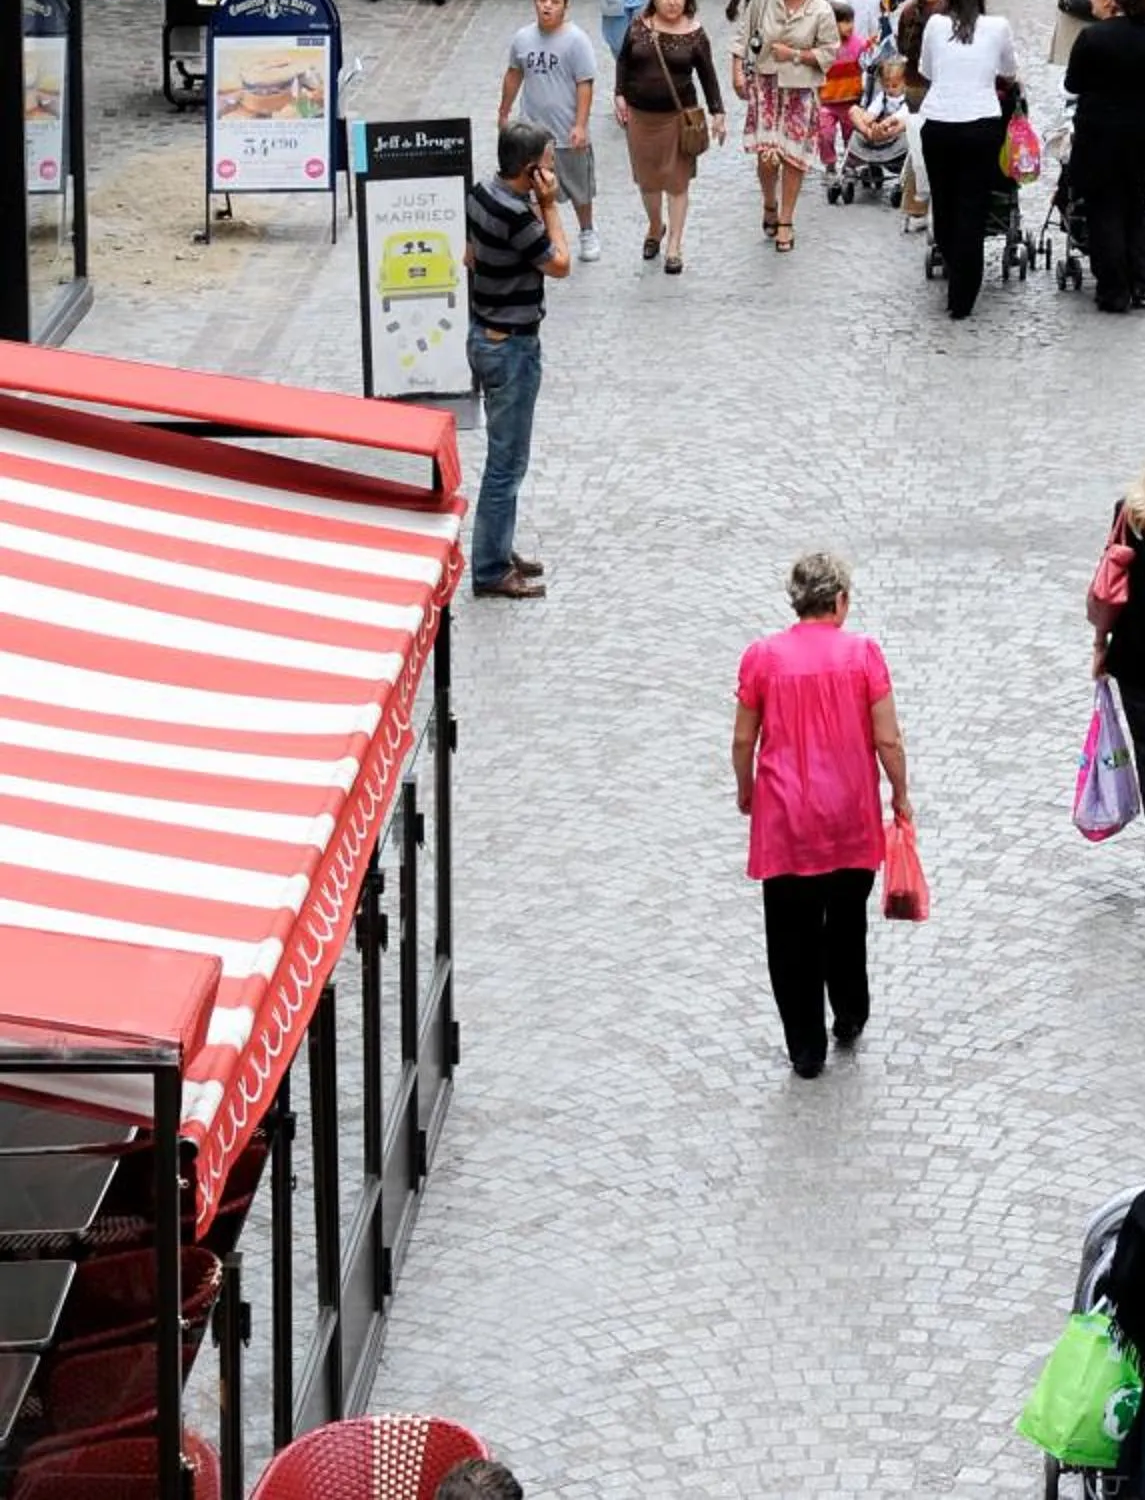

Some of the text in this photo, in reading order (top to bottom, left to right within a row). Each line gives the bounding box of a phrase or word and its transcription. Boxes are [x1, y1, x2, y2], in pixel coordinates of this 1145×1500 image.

[527, 51, 559, 70] GAP
[374, 135, 400, 152] Jeff
[415, 131, 465, 149] Bruges
[391, 193, 438, 208] JUST
[375, 209, 456, 224] MARRIED
